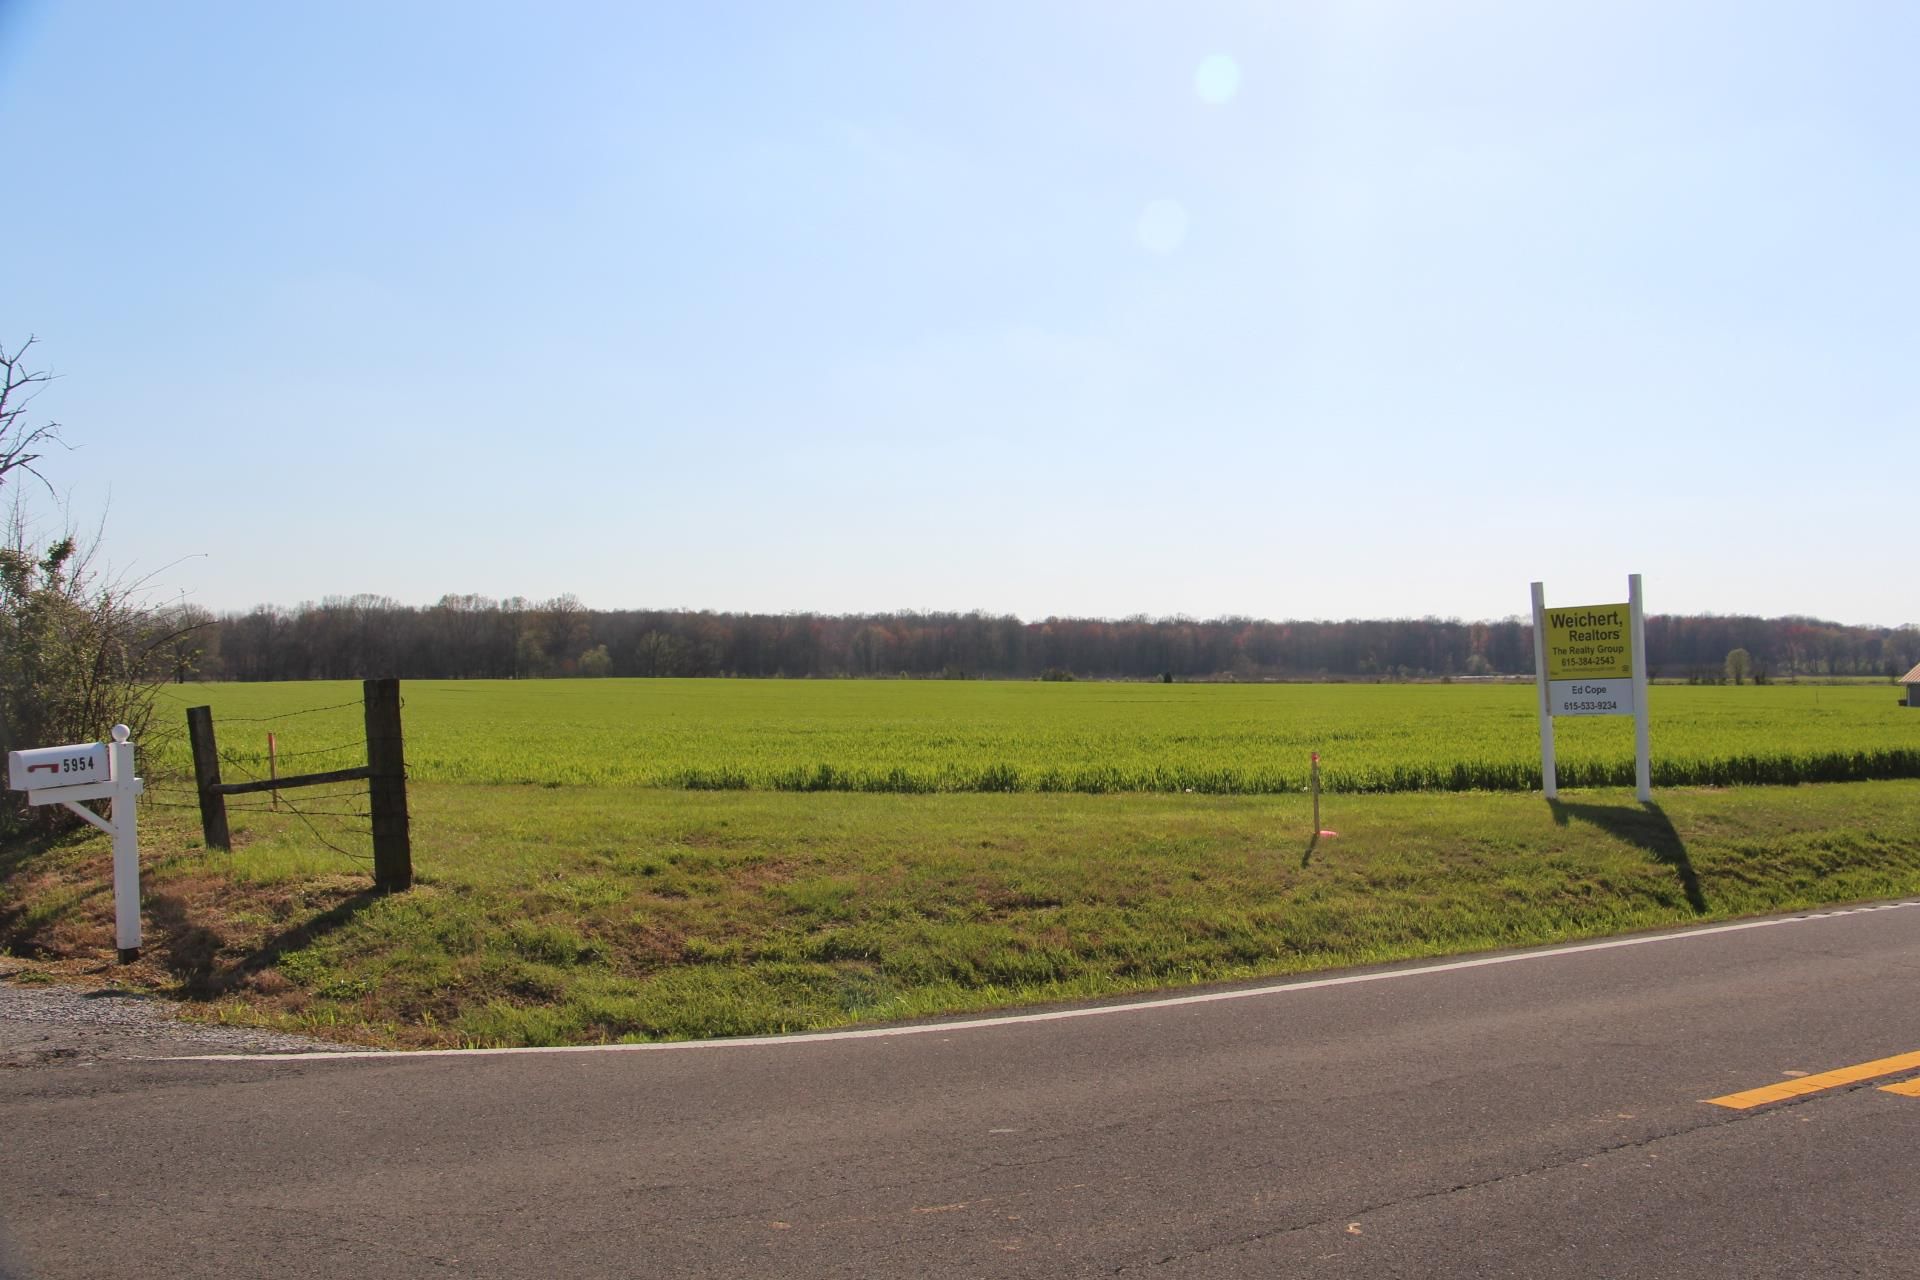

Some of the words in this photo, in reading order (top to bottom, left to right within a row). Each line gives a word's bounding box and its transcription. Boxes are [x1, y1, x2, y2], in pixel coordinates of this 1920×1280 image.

[1551, 611, 1623, 629] Weichert,
[1569, 629, 1620, 642] Realtors
[1552, 647, 1567, 655] The
[1569, 645, 1595, 655] Realty
[1597, 645, 1624, 654] Group
[1561, 656, 1615, 666] 615-384-2543
[1572, 685, 1583, 694] Ed
[1585, 685, 1607, 695] Cope
[1564, 701, 1617, 711] 615-533-9234
[63, 756, 94, 773] 5954
